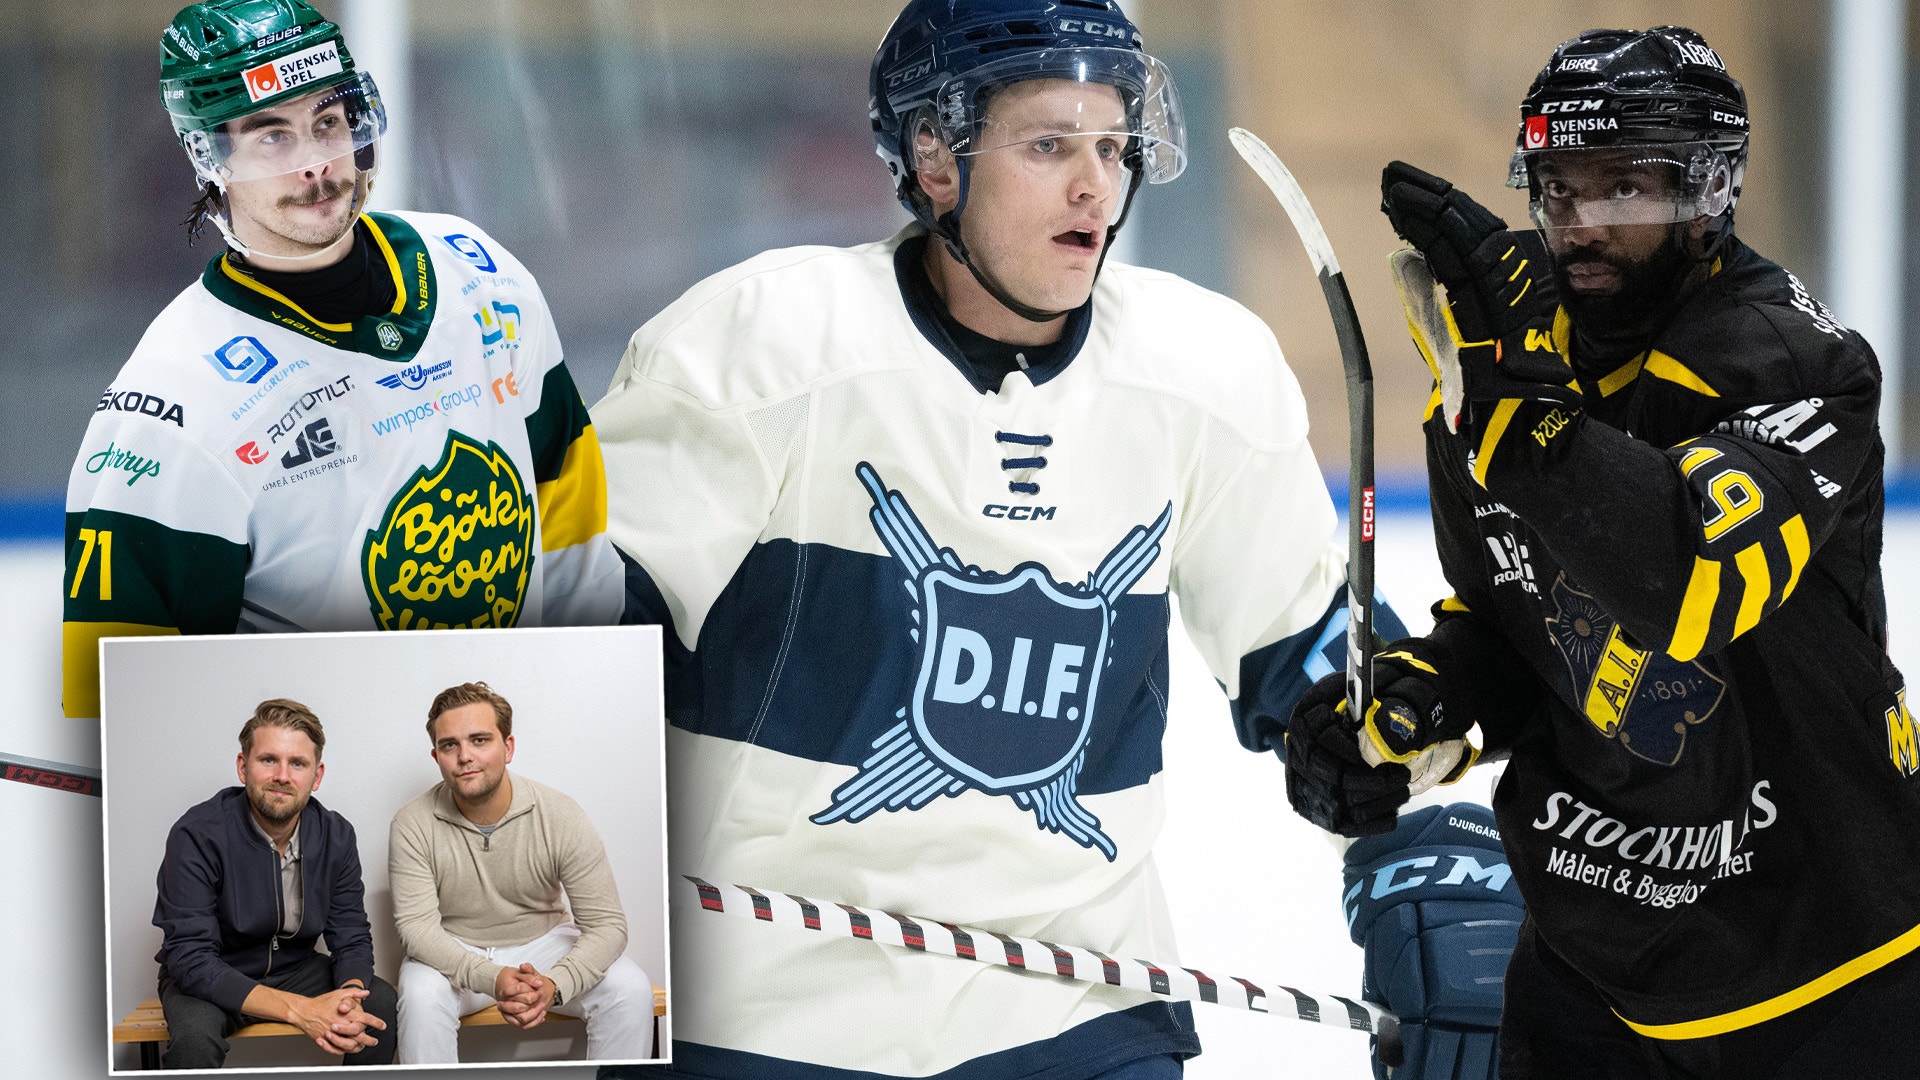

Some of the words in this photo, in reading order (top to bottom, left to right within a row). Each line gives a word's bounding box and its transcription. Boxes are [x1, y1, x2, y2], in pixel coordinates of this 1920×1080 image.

[256, 25, 303, 48] BAUER
[1059, 18, 1126, 39] CCM
[178, 36, 200, 62] BUSS
[279, 49, 338, 77] SVENSKA
[1672, 39, 1726, 71] ÅBRO
[284, 69, 317, 88] SPEL
[888, 61, 933, 88] CCM
[1540, 99, 1605, 115] CCM
[1713, 110, 1745, 127] CCM
[1551, 117, 1619, 133] SVENSKA
[951, 136, 970, 152] CCM
[1552, 133, 1586, 147] SPEL
[417, 251, 429, 300] BAUER
[281, 316, 338, 346] BAUER
[231, 358, 311, 421] BALTICGRUPPEN
[96, 389, 185, 428] ŠKODA
[266, 375, 352, 445] ROTOTILT
[371, 402, 435, 437] winpos
[440, 383, 483, 409] Group
[85, 441, 161, 487] Jerrys
[262, 476, 288, 492] UMEÅ
[982, 503, 1057, 521] CCM
[1363, 491, 1374, 538] CCM
[69, 527, 112, 600] 71
[932, 625, 1085, 721] D.I.F.
[12, 768, 87, 791] CCM
[1546, 846, 1612, 889] Måleri
[1612, 868, 1631, 896] &
[1341, 854, 1513, 932] CCM
